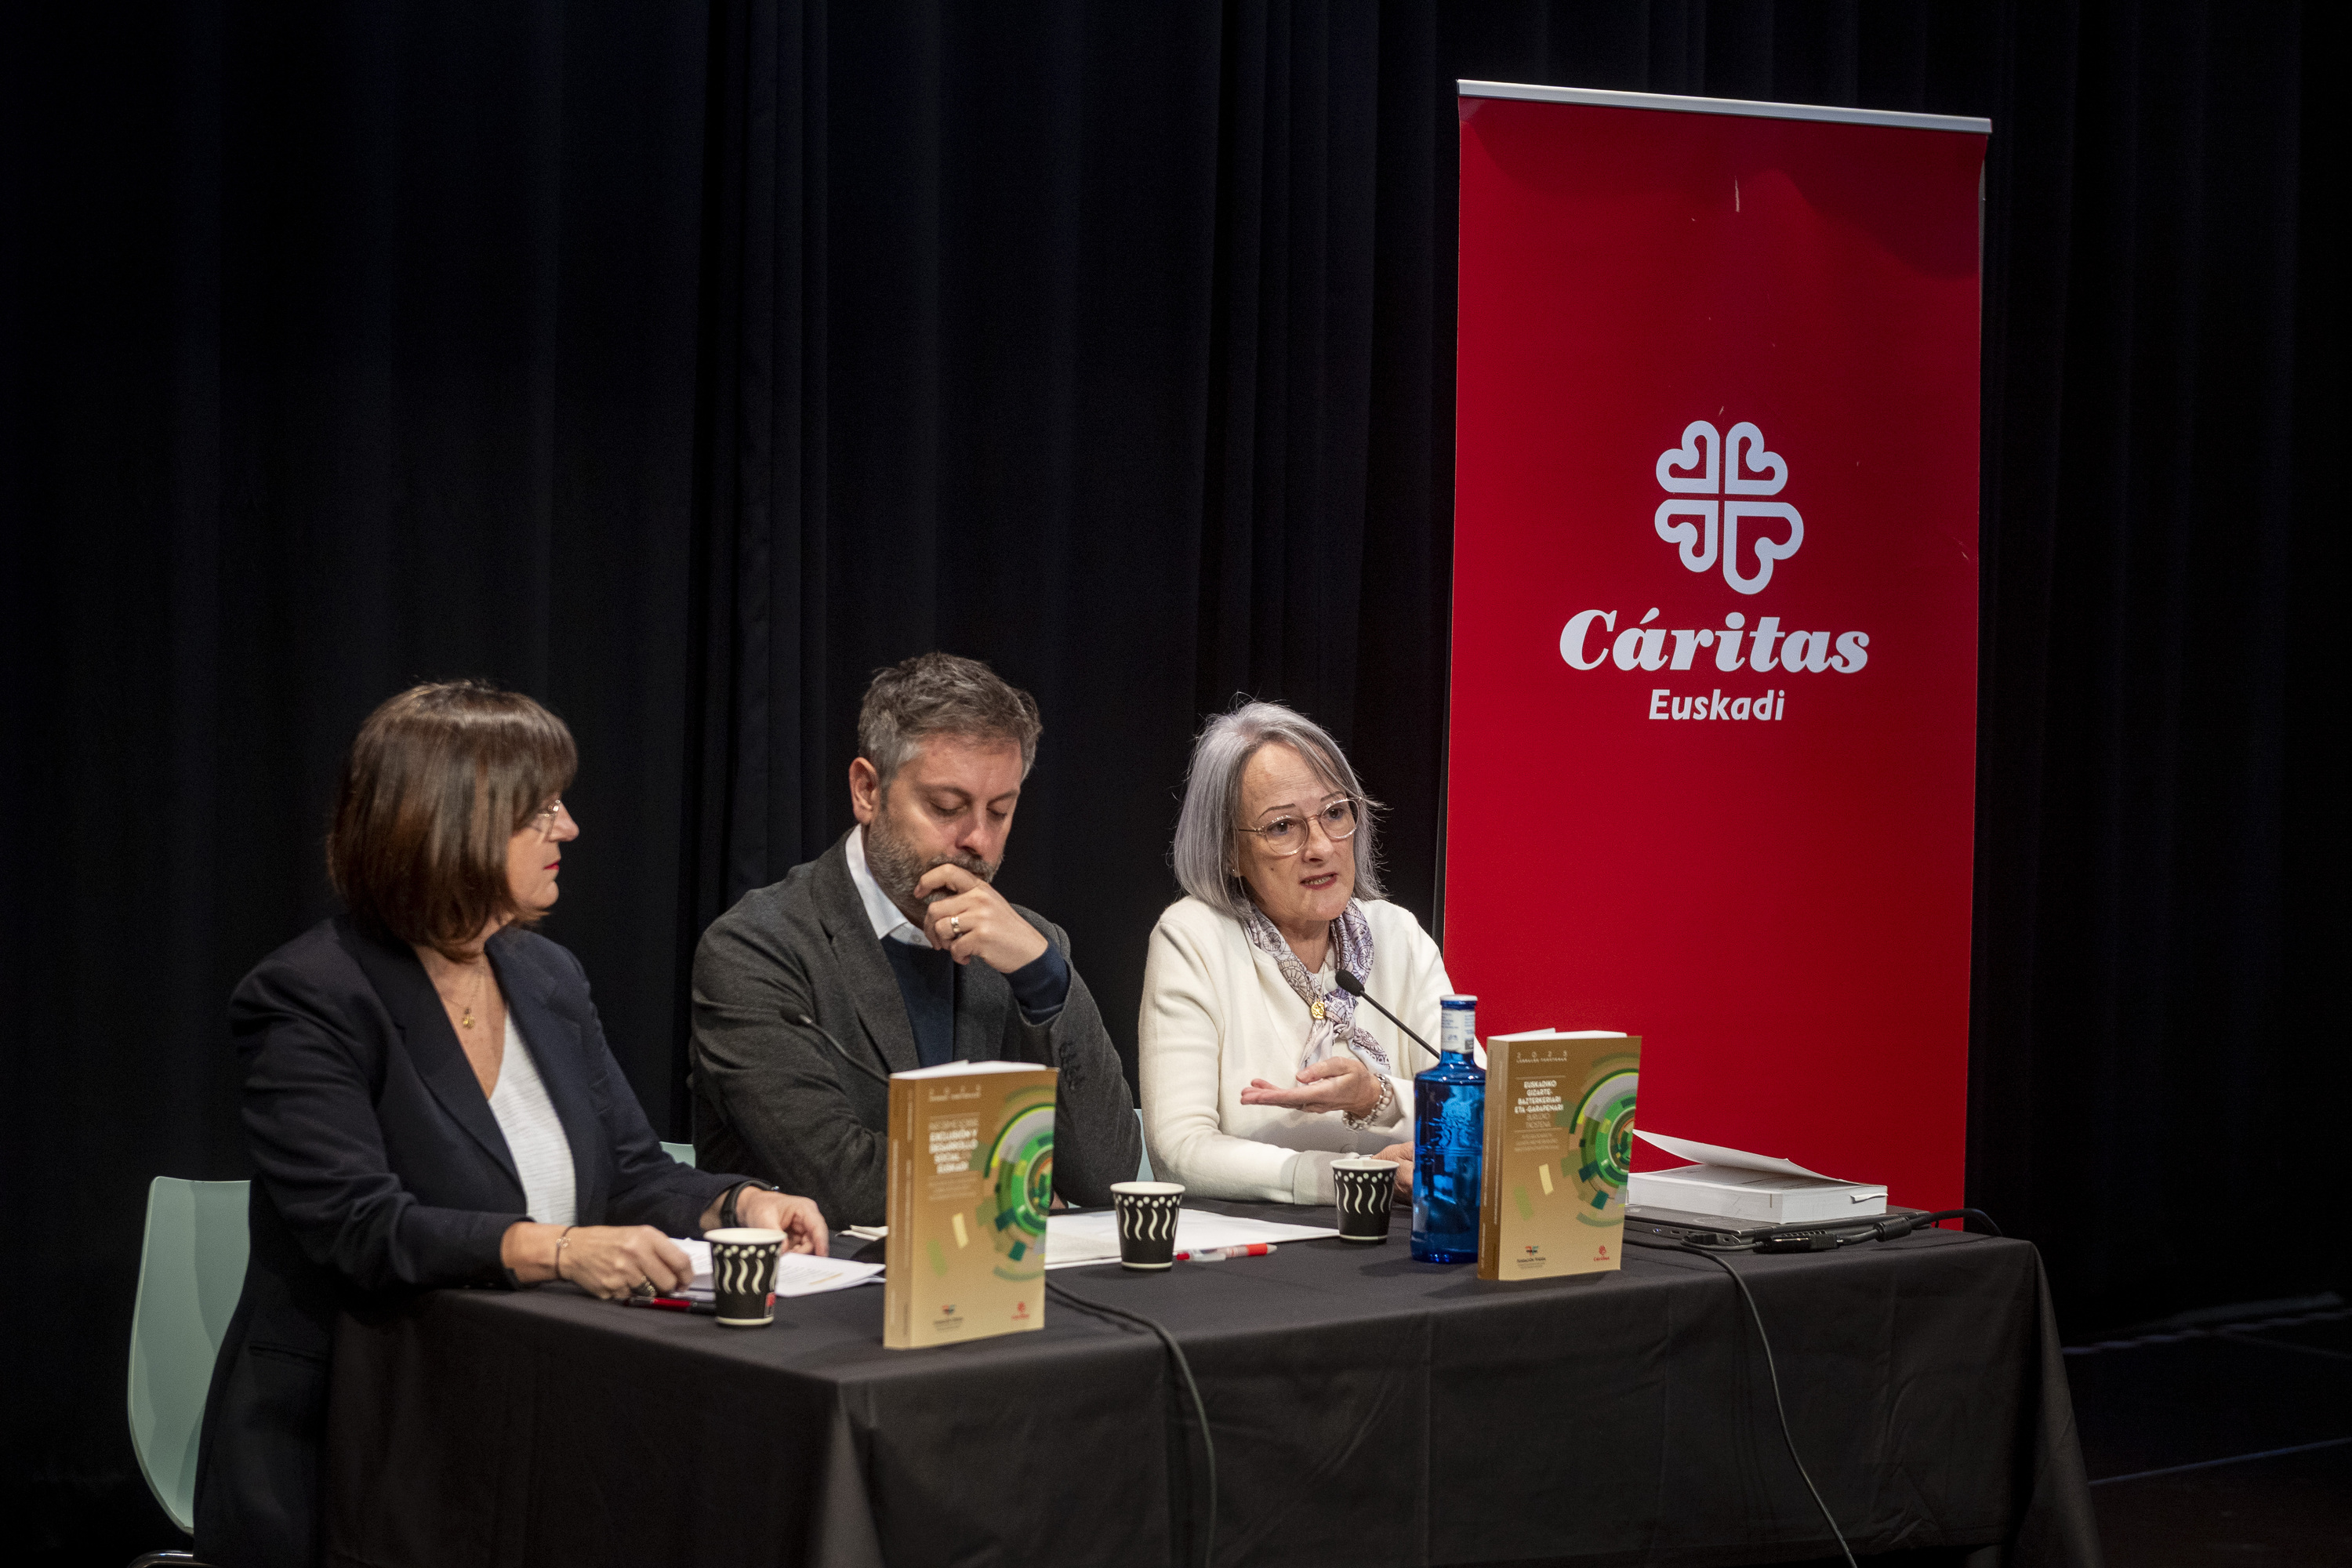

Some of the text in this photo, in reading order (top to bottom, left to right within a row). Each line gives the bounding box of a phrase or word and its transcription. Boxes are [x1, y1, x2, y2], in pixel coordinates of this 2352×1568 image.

[1559, 608, 1870, 673] Cáritas
[1649, 689, 1785, 720] Euskadi
[1523, 1080, 1557, 1089] EUSKADIKO
